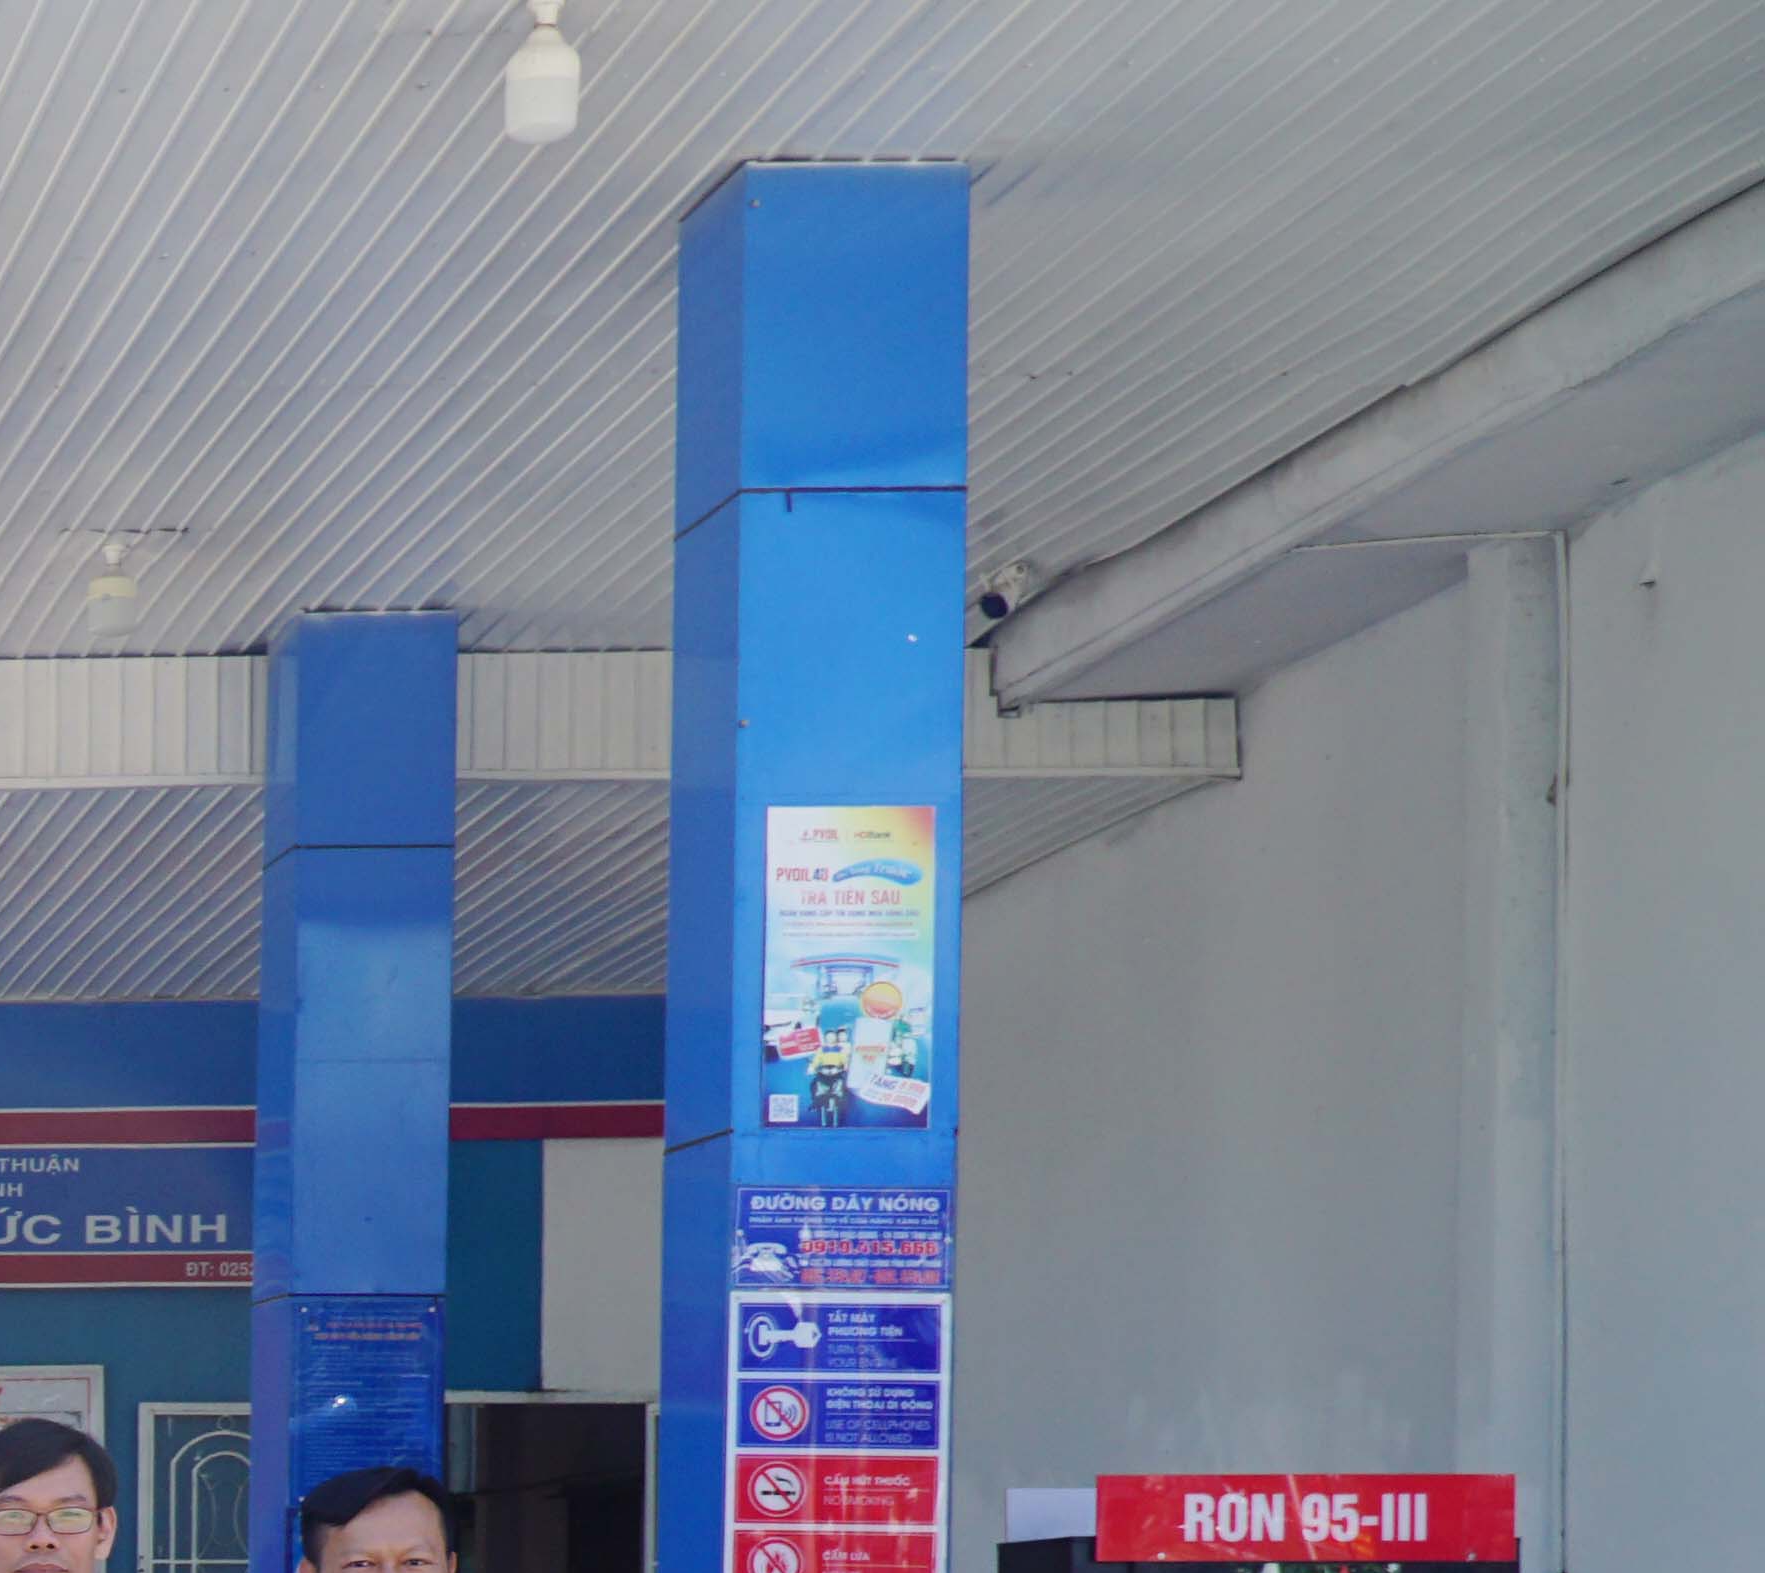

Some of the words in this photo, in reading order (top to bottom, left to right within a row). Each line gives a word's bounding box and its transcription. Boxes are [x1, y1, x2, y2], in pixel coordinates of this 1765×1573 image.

[750, 1193, 826, 1212] ĐƯỜNG
[831, 1195, 872, 1212] DÂY
[878, 1195, 940, 1212] NÓNG
[85, 1206, 228, 1244] BÌNH
[185, 1262, 214, 1277] ĐT:
[1183, 1493, 1285, 1543] RON
[1301, 1492, 1428, 1542] 95-III
